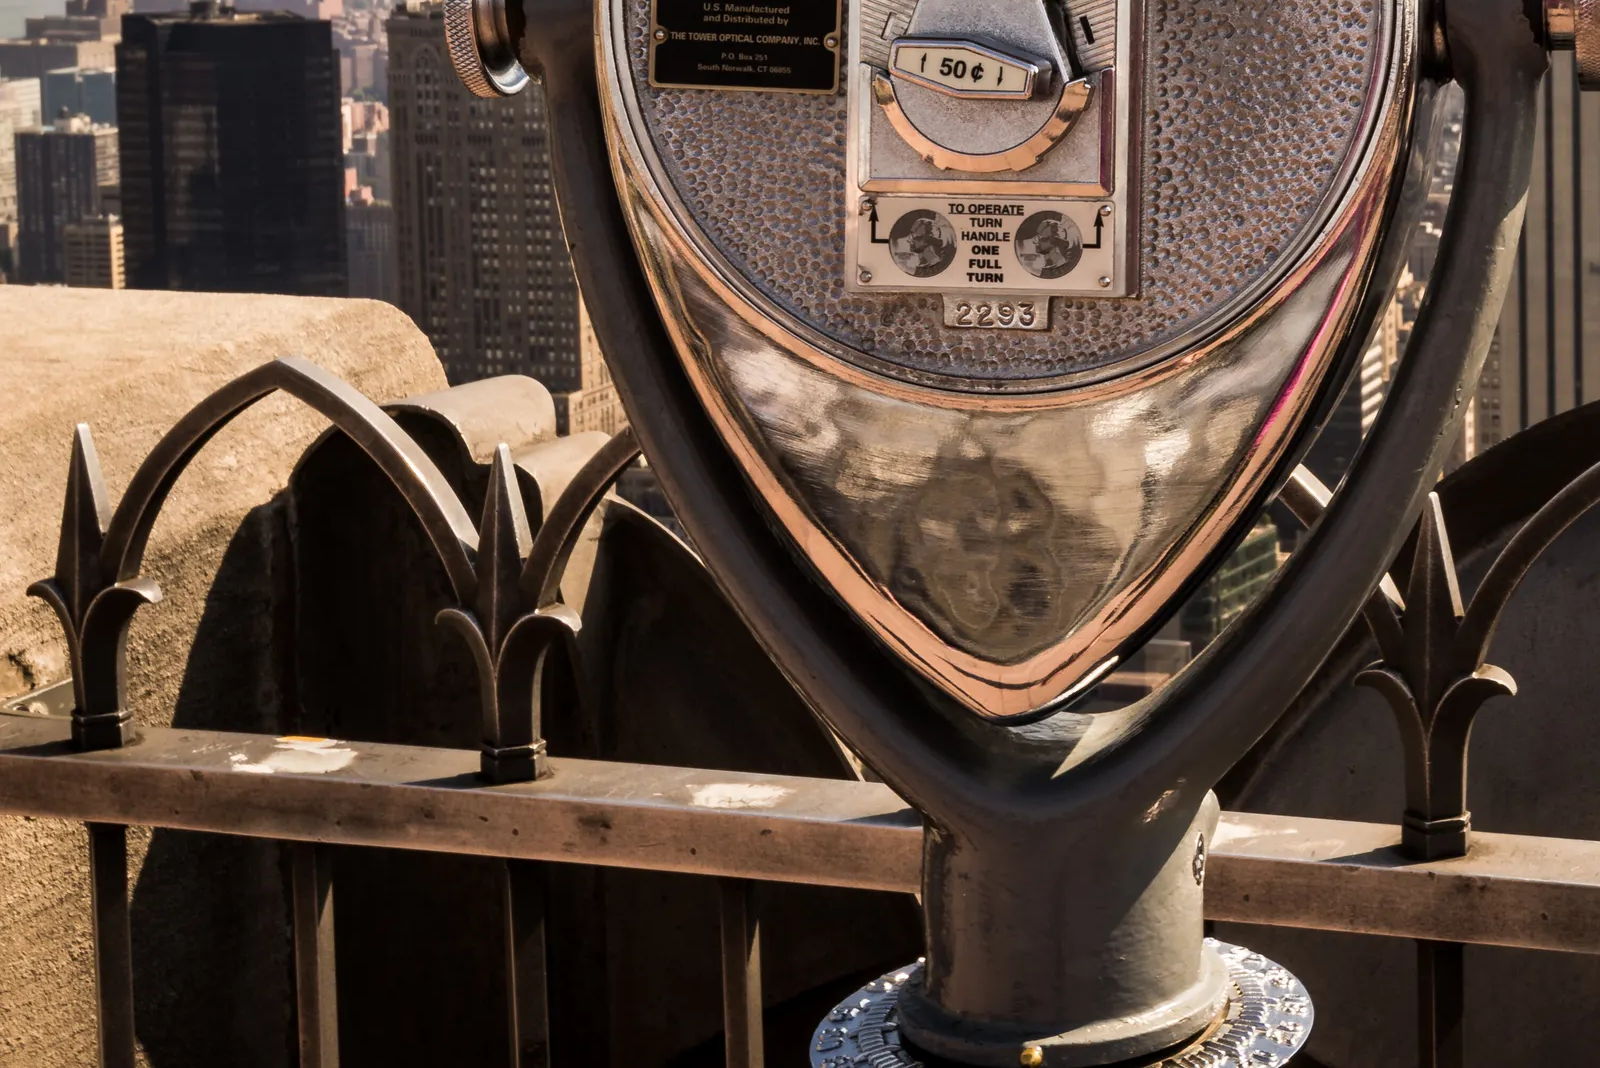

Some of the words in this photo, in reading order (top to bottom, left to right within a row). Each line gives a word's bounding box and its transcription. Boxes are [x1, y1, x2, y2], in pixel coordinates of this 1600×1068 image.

[703, 3, 722, 12] U.S.
[725, 4, 790, 15] Manufactured
[703, 14, 721, 23] and
[723, 14, 775, 25] Distributed
[777, 16, 789, 26] by
[670, 31, 686, 40] THE
[688, 32, 717, 42] TOWER
[719, 33, 754, 43] OPTICAL
[756, 35, 802, 46] COMPANY,
[803, 37, 821, 46] INC.
[738, 53, 753, 61] Box
[697, 63, 720, 71] South
[757, 65, 768, 73] CT
[948, 203, 966, 215] TO
[968, 204, 1024, 216] OPERATE
[969, 218, 1002, 228] TURN
[961, 231, 1010, 242] HANDLE
[971, 245, 999, 256] ONE
[969, 259, 1002, 270] FULL
[967, 273, 1003, 283] TURN
[956, 301, 1035, 326] 2293
